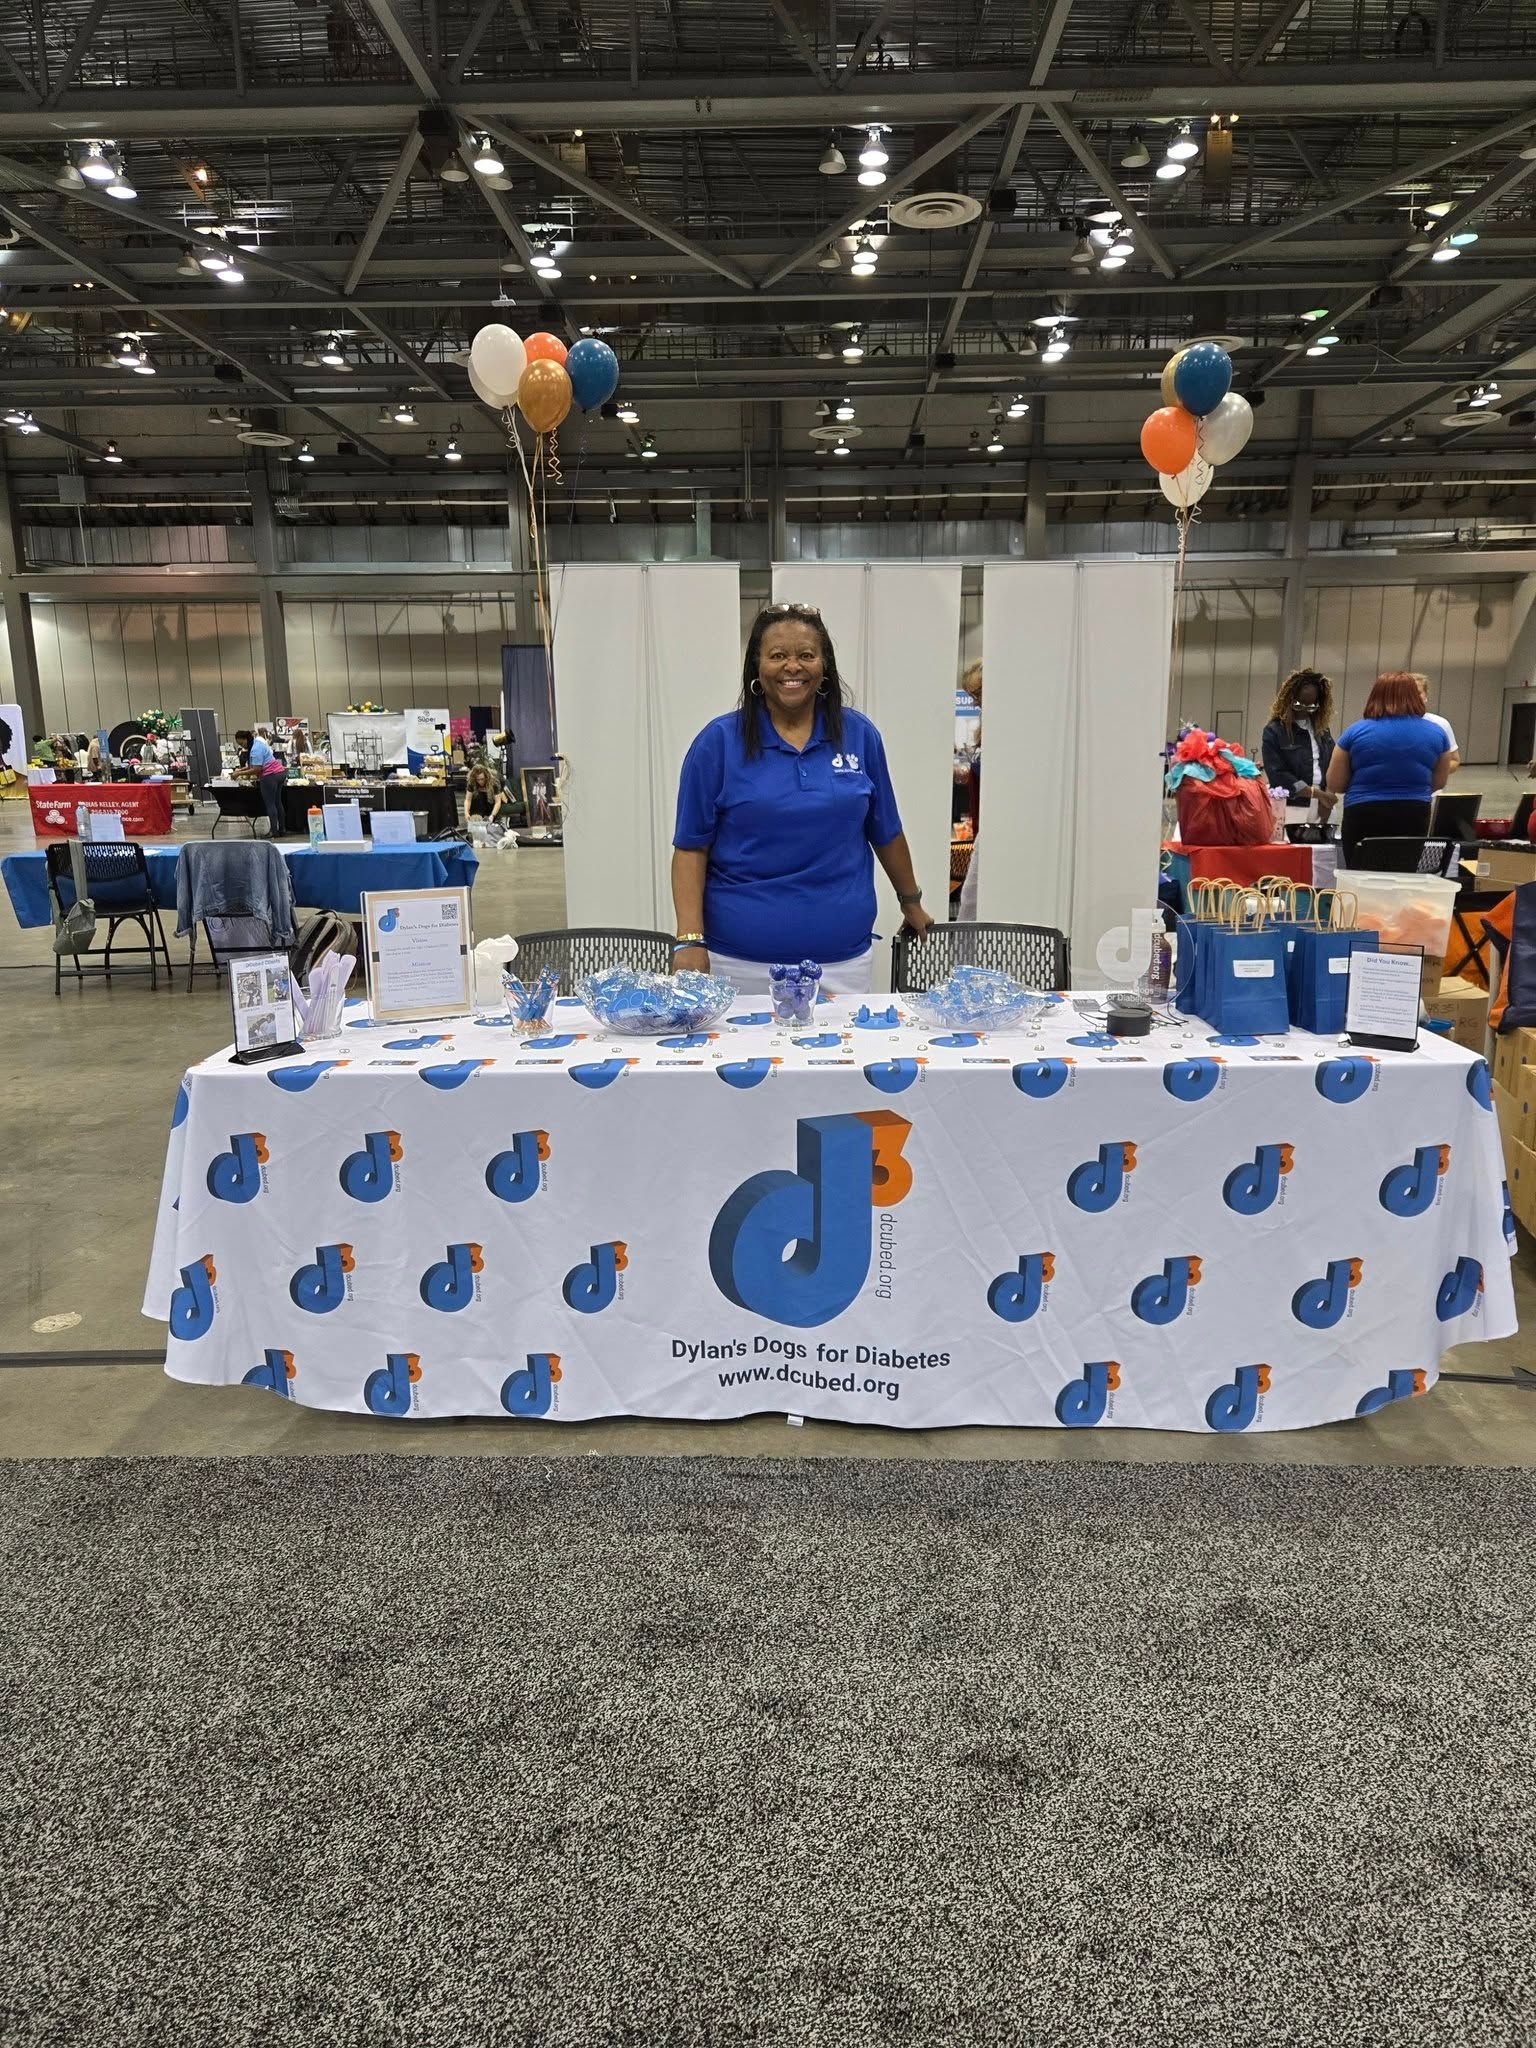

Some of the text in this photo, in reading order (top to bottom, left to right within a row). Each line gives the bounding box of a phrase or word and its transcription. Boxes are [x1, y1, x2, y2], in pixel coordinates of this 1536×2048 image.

[1152, 933, 1163, 980] dcubed.org
[260, 1165, 269, 1194] dcubed.org
[393, 1163, 401, 1193] dcubed.org
[540, 1162, 548, 1192] dcubed.org
[1122, 1173, 1131, 1203] dcubed.org
[1278, 1175, 1288, 1206] dcubed.org
[875, 1213, 897, 1299] dcubed.org
[345, 1273, 353, 1302] dcubed.org
[474, 1274, 482, 1302] dcubed.org
[616, 1273, 624, 1301] dcubed.org
[1041, 1283, 1050, 1312] dcubed.org
[1186, 1287, 1195, 1316] dcubed.org
[1346, 1289, 1355, 1318] dcubed.org
[671, 1335, 951, 1370] Dylan's Dogs for Diabetes
[718, 1364, 900, 1400] www.dcubed.org
[1106, 1391, 1115, 1419] dcubed.org
[1256, 1394, 1265, 1423] dcubed.org
